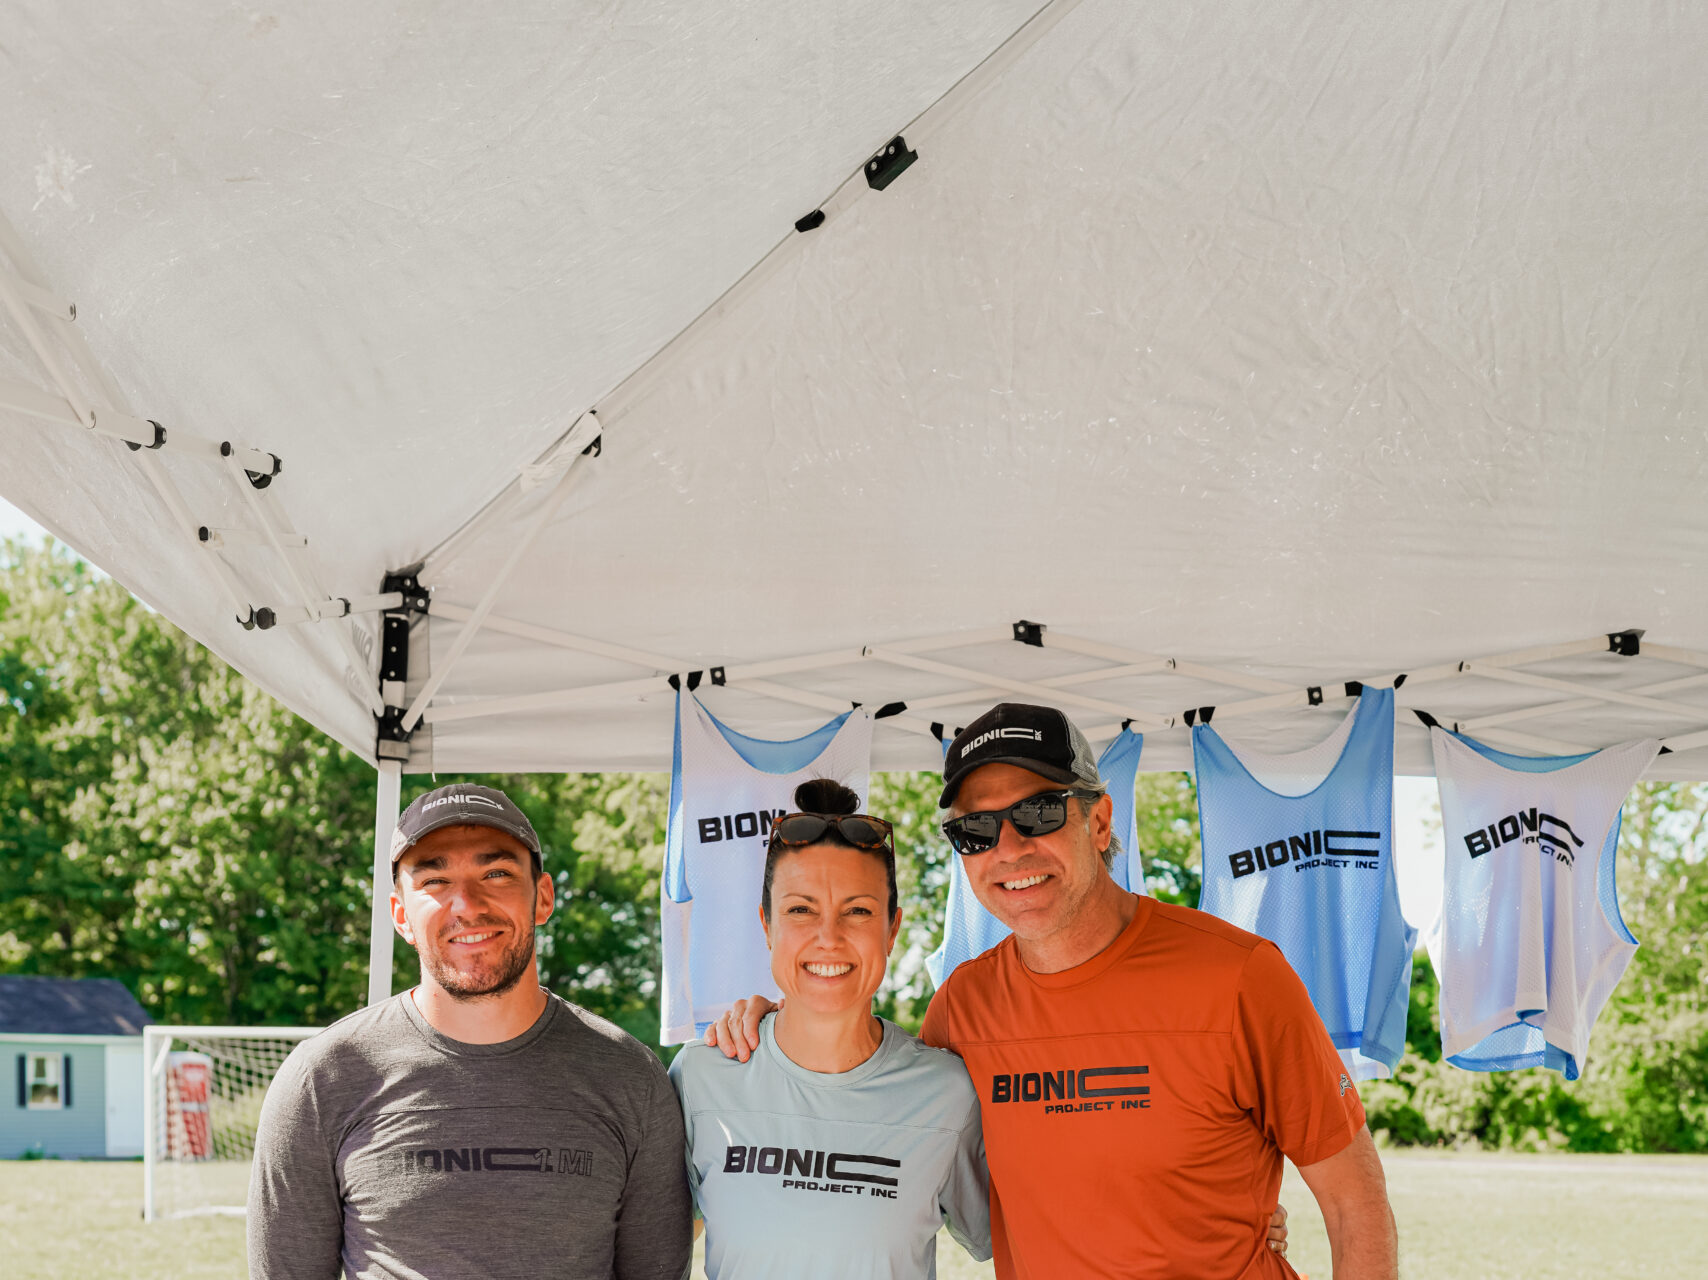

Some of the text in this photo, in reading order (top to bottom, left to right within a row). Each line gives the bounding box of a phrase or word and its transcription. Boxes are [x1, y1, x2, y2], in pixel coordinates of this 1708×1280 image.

[961, 727, 1034, 758] BIONIC
[421, 794, 500, 813] BIONIC
[1228, 830, 1381, 879] BIONIC
[1295, 858, 1379, 872] PROJECT INC
[991, 1065, 1150, 1103] BIONIC
[1045, 1099, 1151, 1114] PROJECT INC
[723, 1145, 901, 1187] BIONIC
[782, 1179, 898, 1199] PROJECT INC
